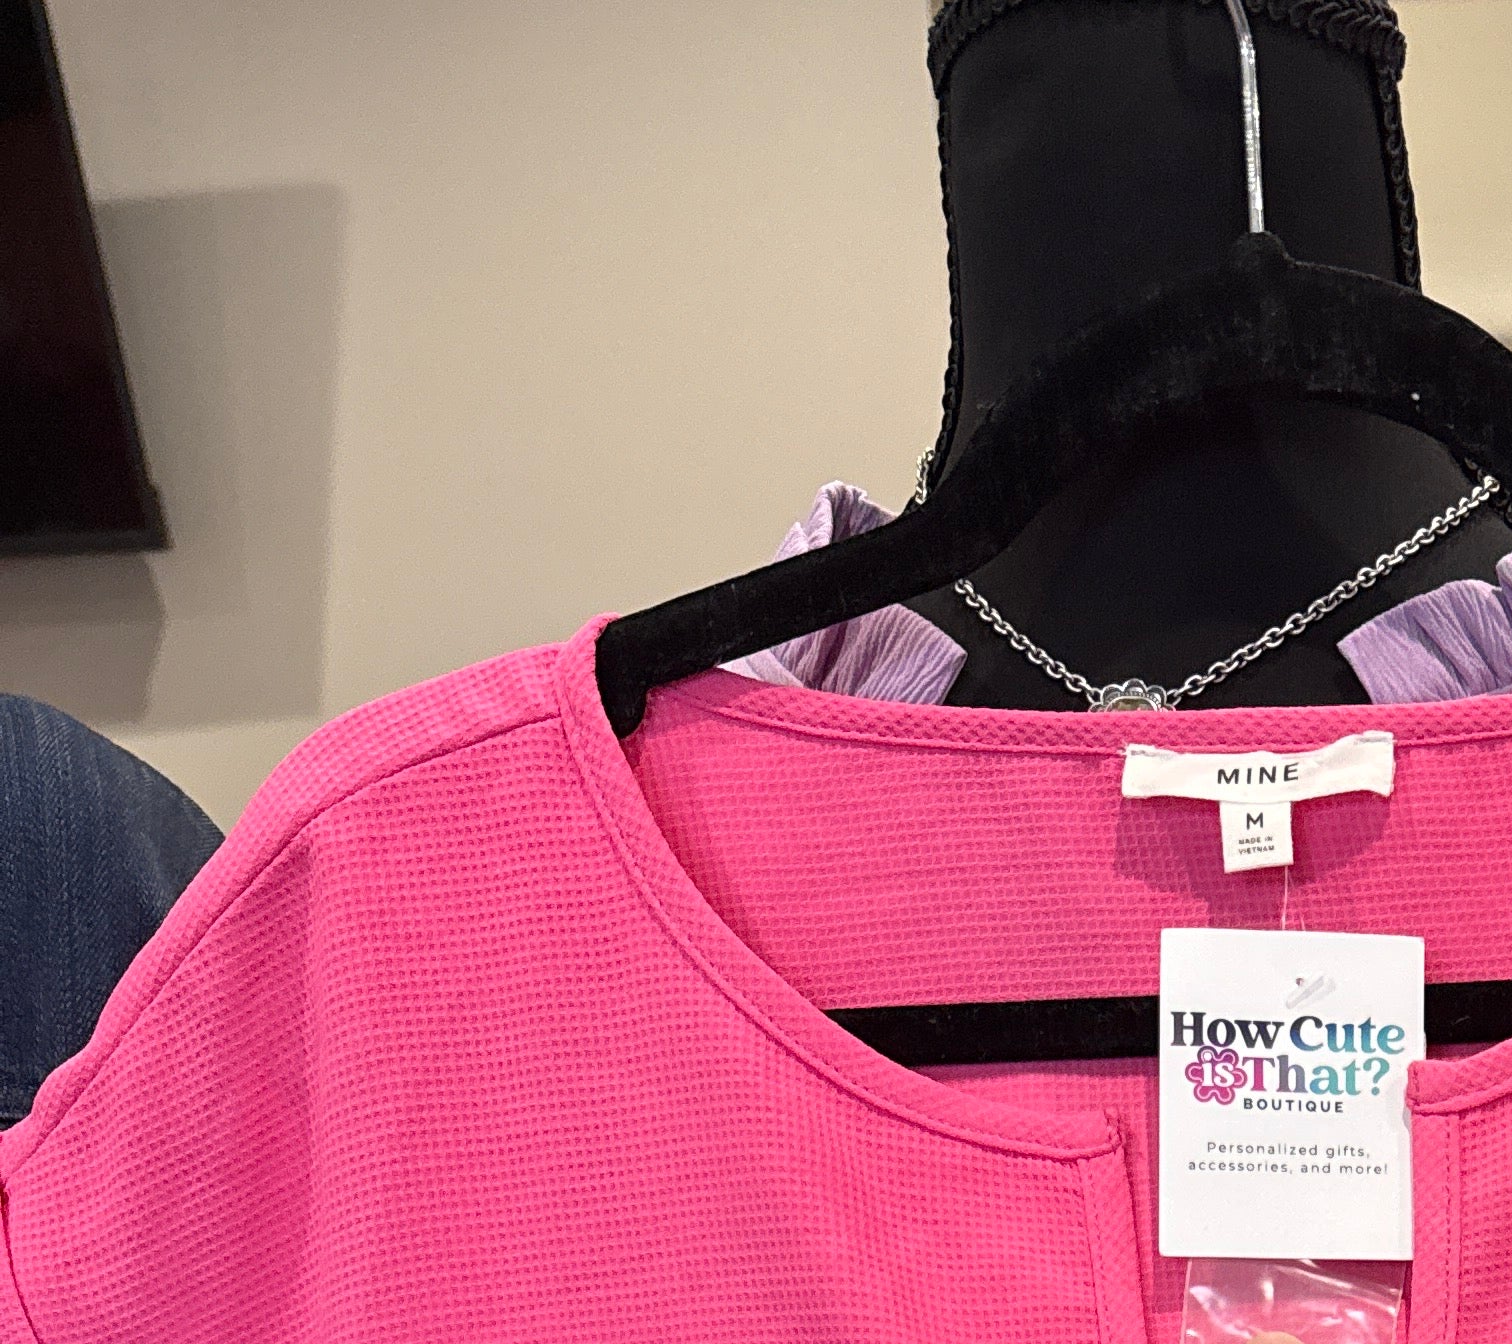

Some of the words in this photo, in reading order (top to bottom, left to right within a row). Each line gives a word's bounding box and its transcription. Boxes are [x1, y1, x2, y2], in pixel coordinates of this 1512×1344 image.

[1217, 762, 1299, 785] MINE
[1246, 812, 1264, 830] M
[1238, 836, 1261, 845] MADE
[1170, 1011, 1285, 1049] How
[1289, 1015, 1406, 1054] Cute
[1200, 1050, 1236, 1087] is
[1241, 1055, 1390, 1096] That?
[1243, 1098, 1344, 1113] BOUTIQUE
[1206, 1141, 1318, 1157] Personalized
[1325, 1144, 1371, 1159] gifts,
[1187, 1160, 1294, 1175] accessories,
[1299, 1162, 1332, 1175] and
[1338, 1162, 1389, 1175] more!
